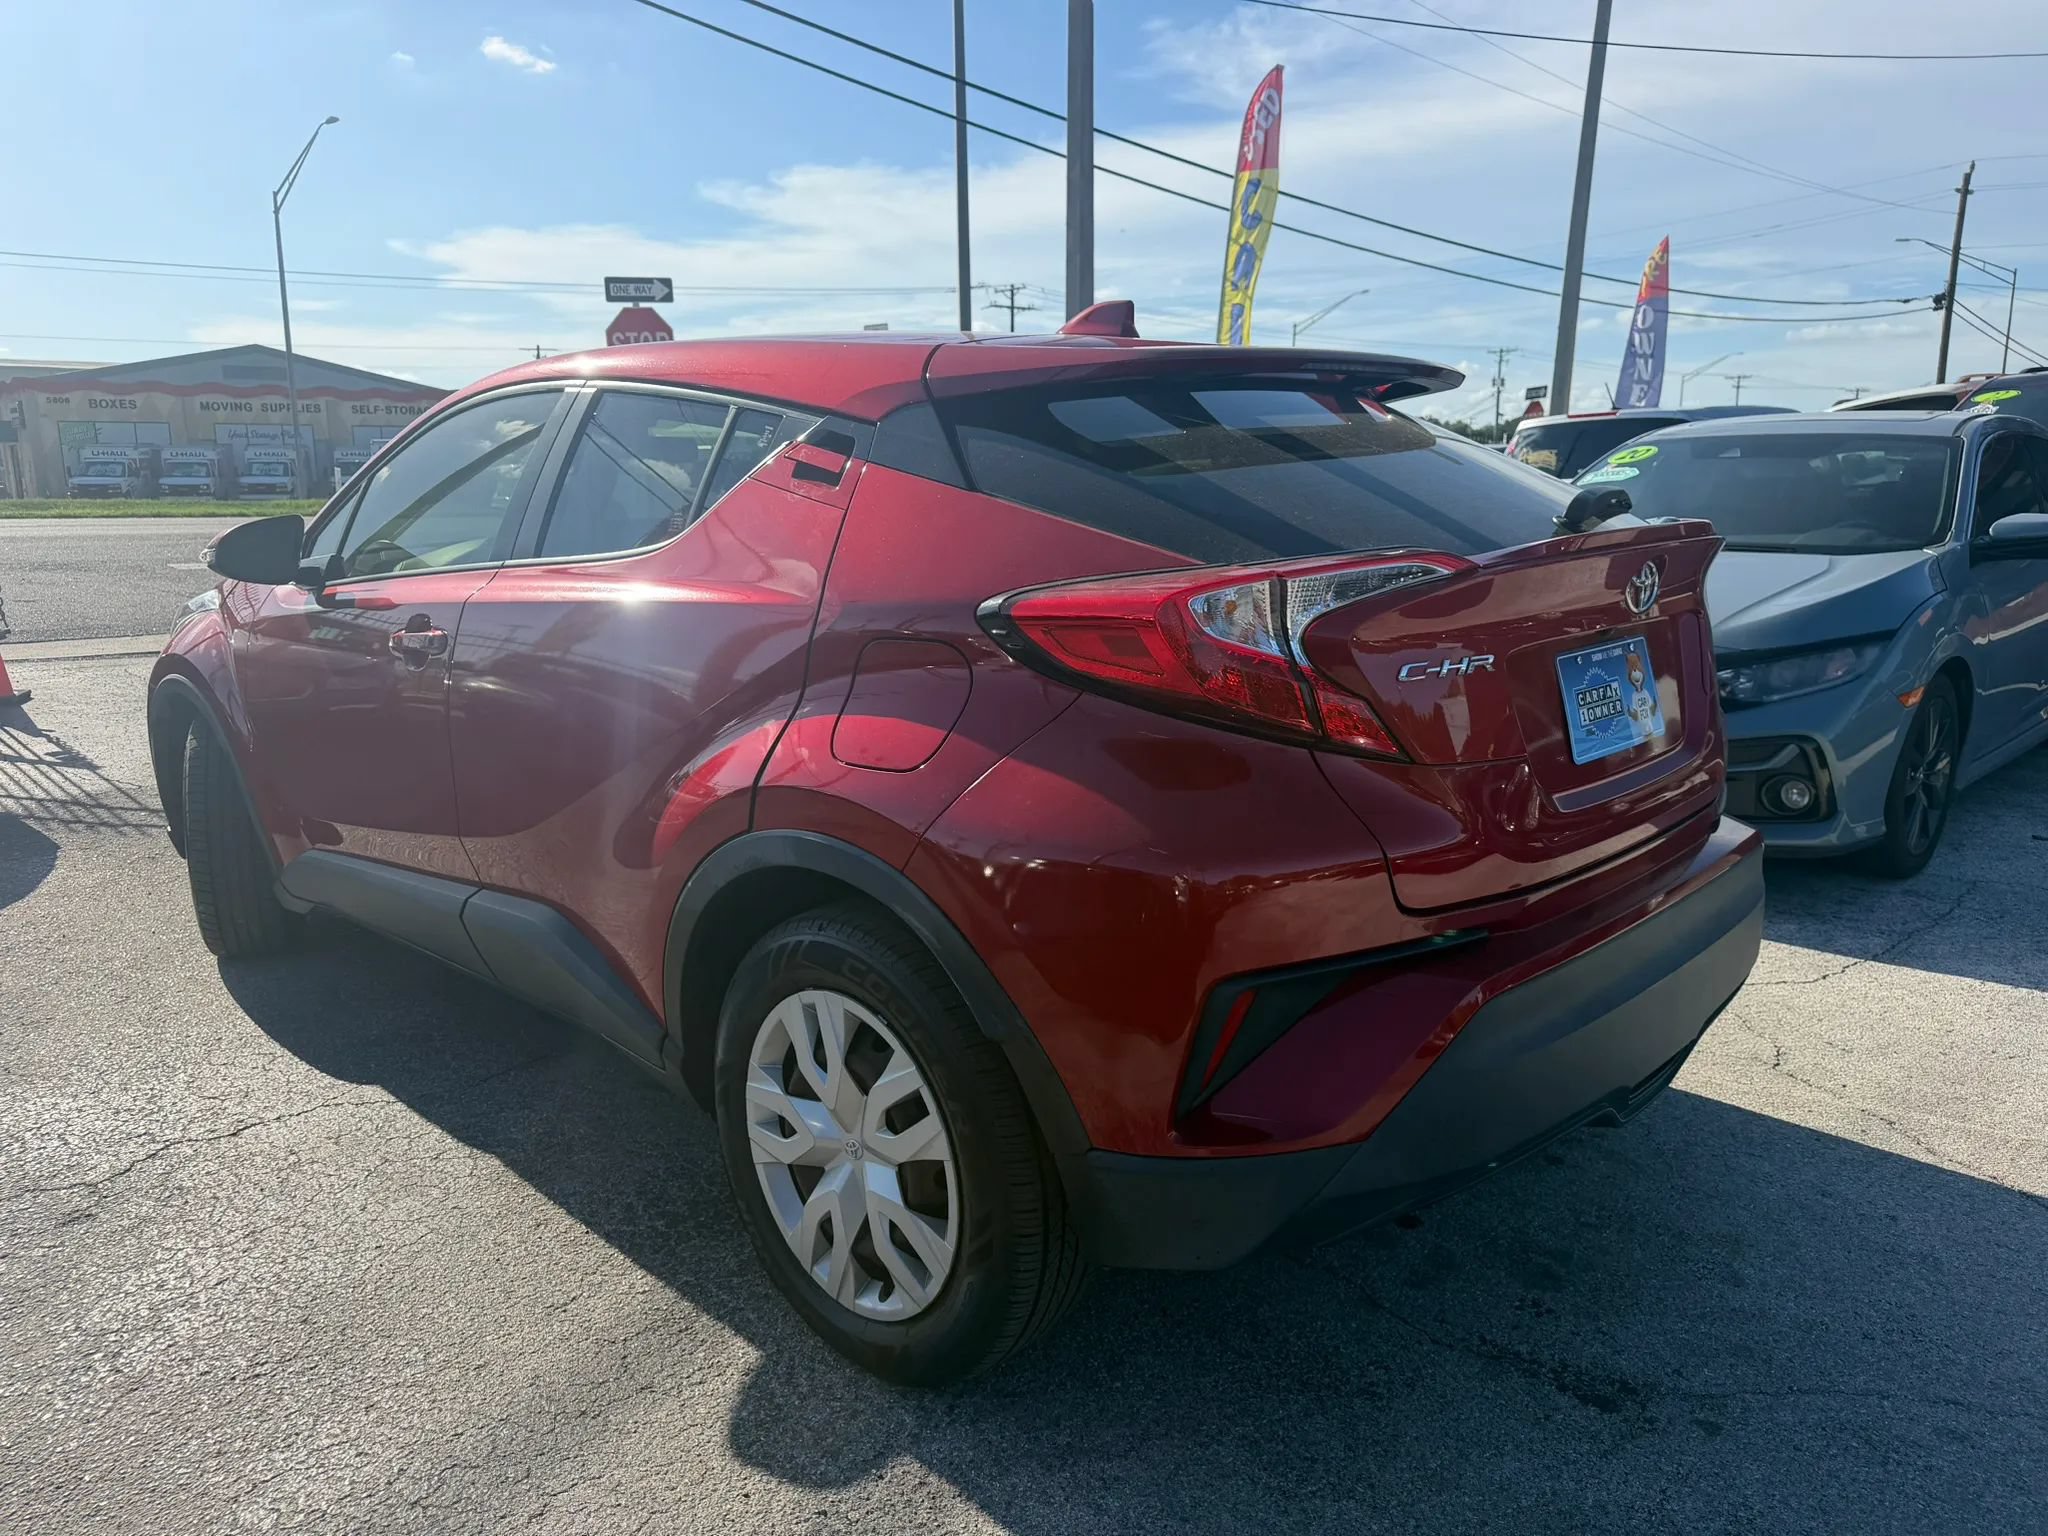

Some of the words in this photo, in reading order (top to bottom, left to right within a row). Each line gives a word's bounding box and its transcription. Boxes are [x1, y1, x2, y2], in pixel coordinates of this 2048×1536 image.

[612, 284, 631, 295] ONE
[634, 284, 653, 295] WAY
[1630, 304, 1656, 407] OWNE
[88, 398, 137, 410] BOXES
[199, 401, 253, 413] MOVING
[1398, 654, 1495, 681] C-HR
[1577, 684, 1620, 705] CARFAX
[1588, 700, 1622, 720] OWNER
